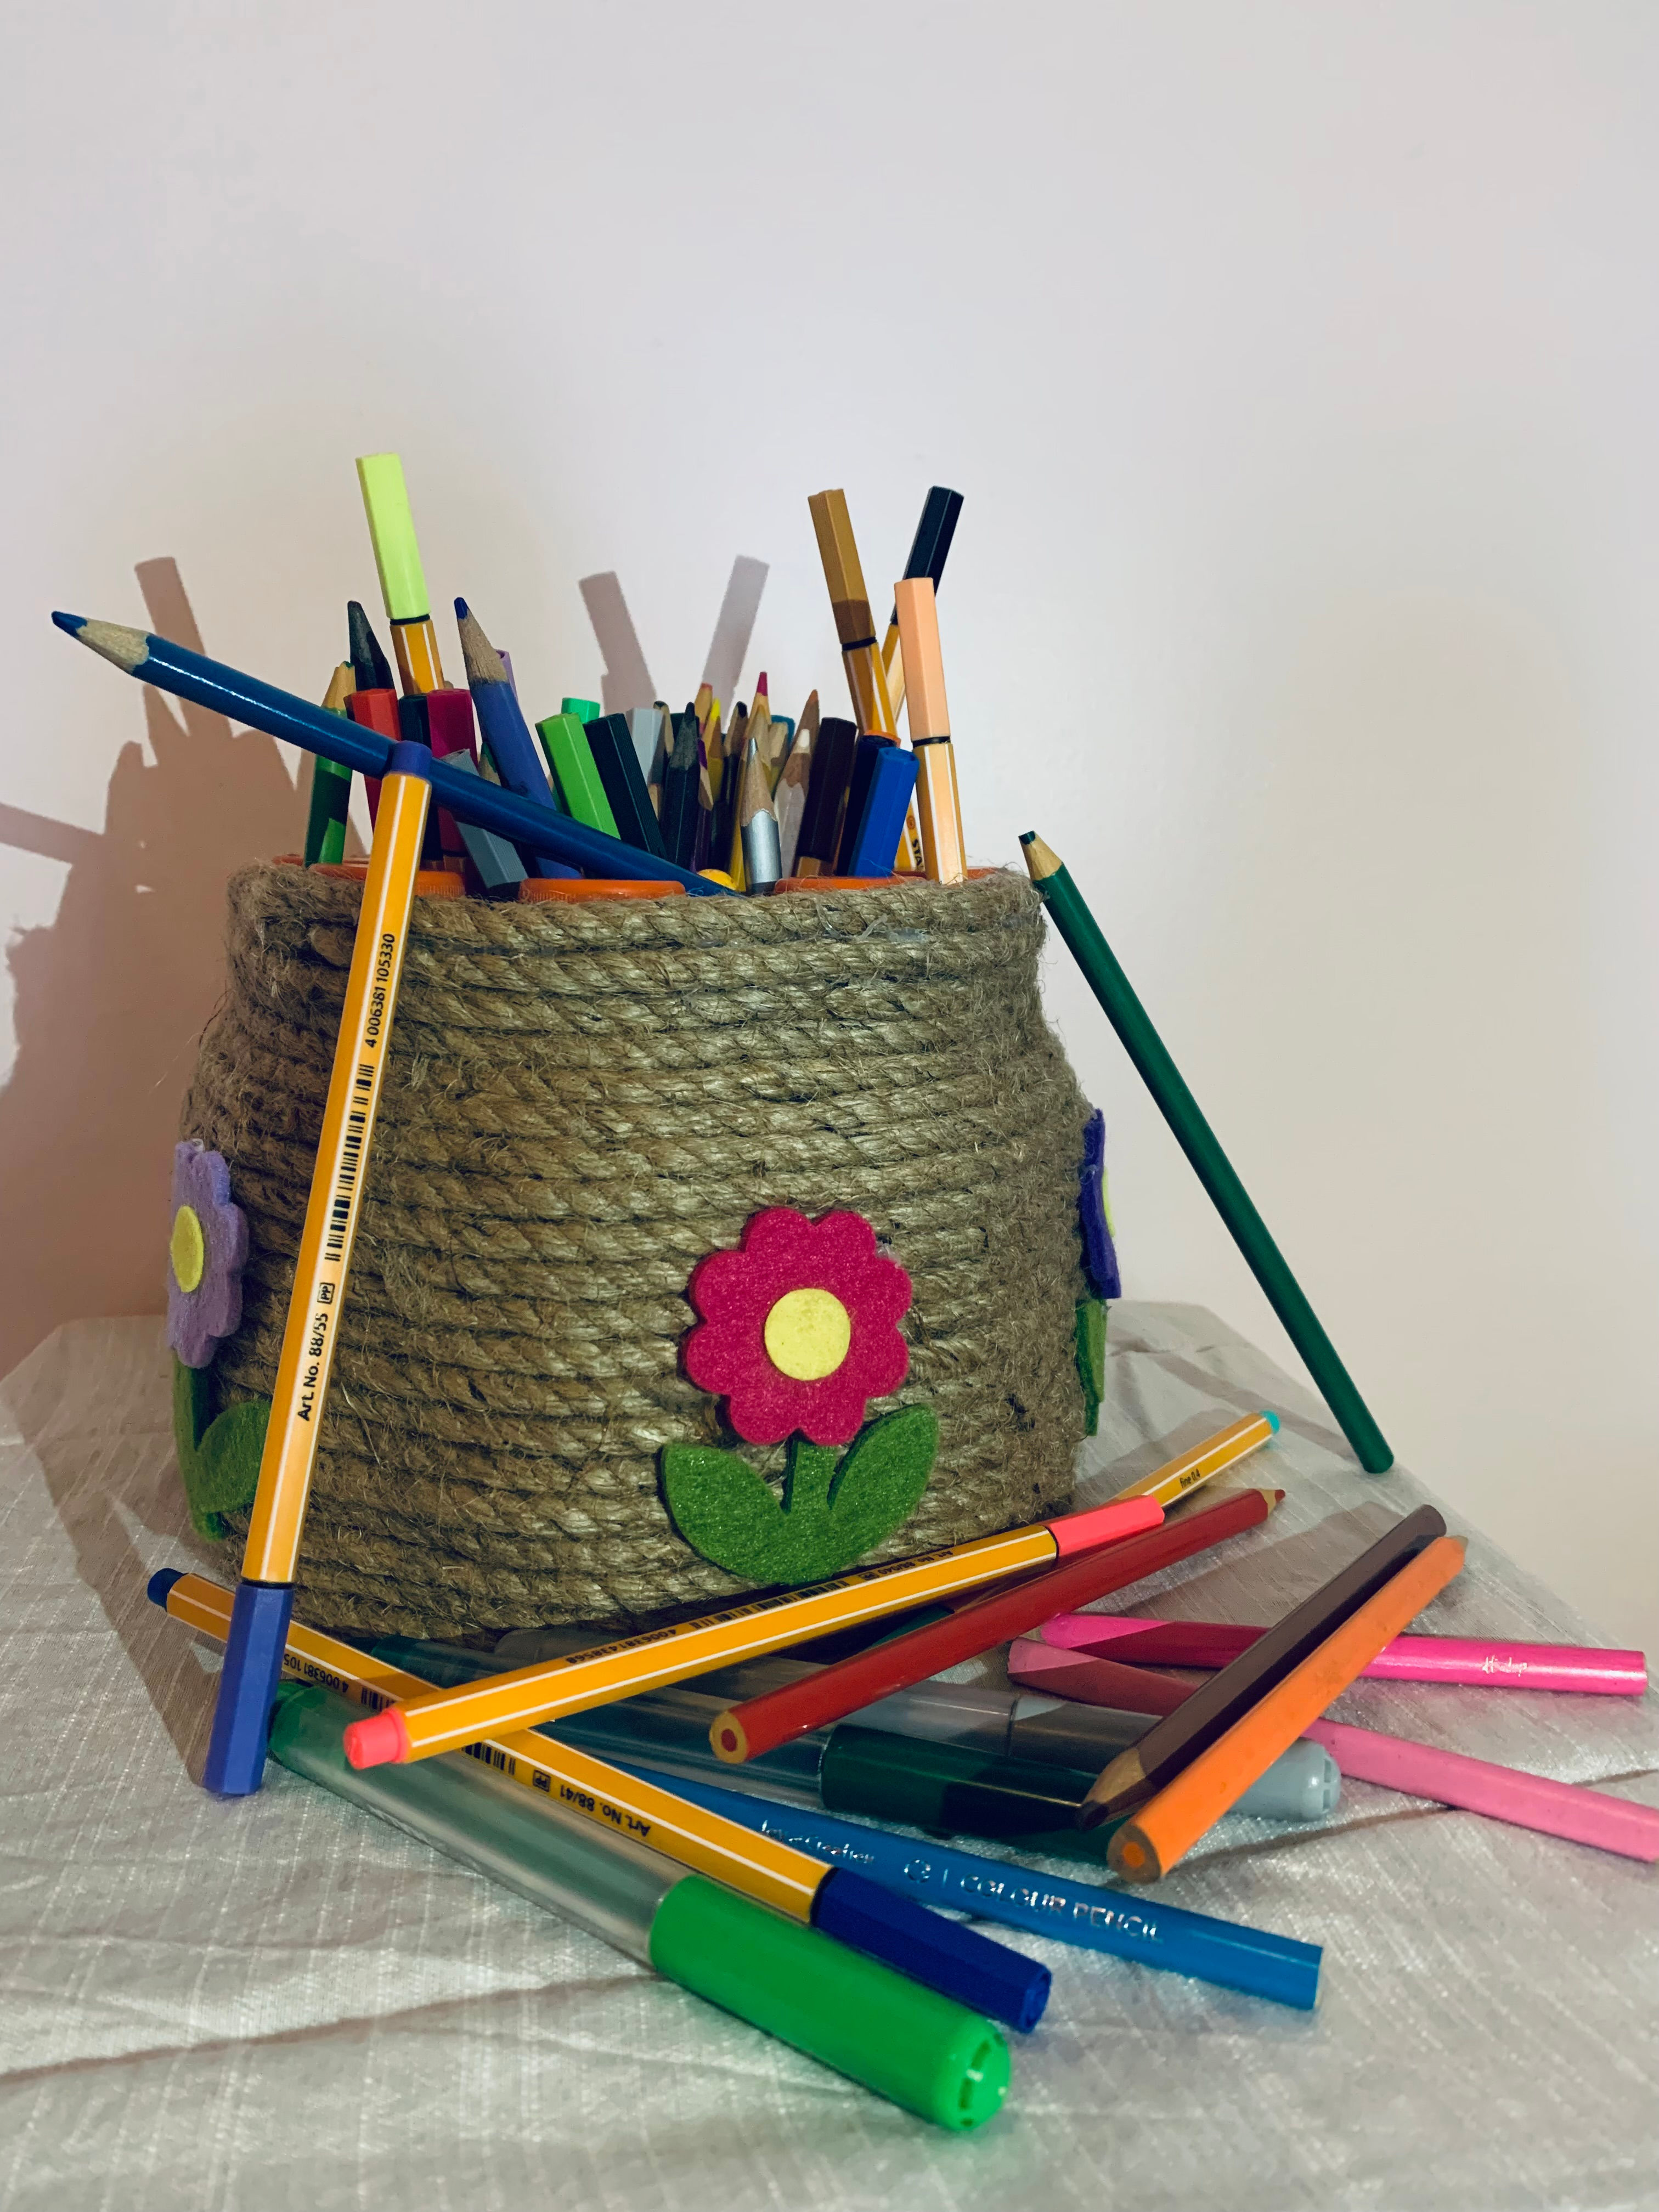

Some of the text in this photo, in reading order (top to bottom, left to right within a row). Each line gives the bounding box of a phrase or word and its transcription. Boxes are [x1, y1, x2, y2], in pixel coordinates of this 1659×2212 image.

[912, 838, 924, 869] STA
[364, 1038, 377, 1048] 4
[308, 1312, 329, 1357] 88/55
[303, 1362, 320, 1388] No.
[342, 1680, 349, 1693] 4
[560, 1784, 595, 1812] 88/41
[599, 1802, 622, 1825] No.
[960, 1873, 1164, 1943] COLOUR PENCIL
